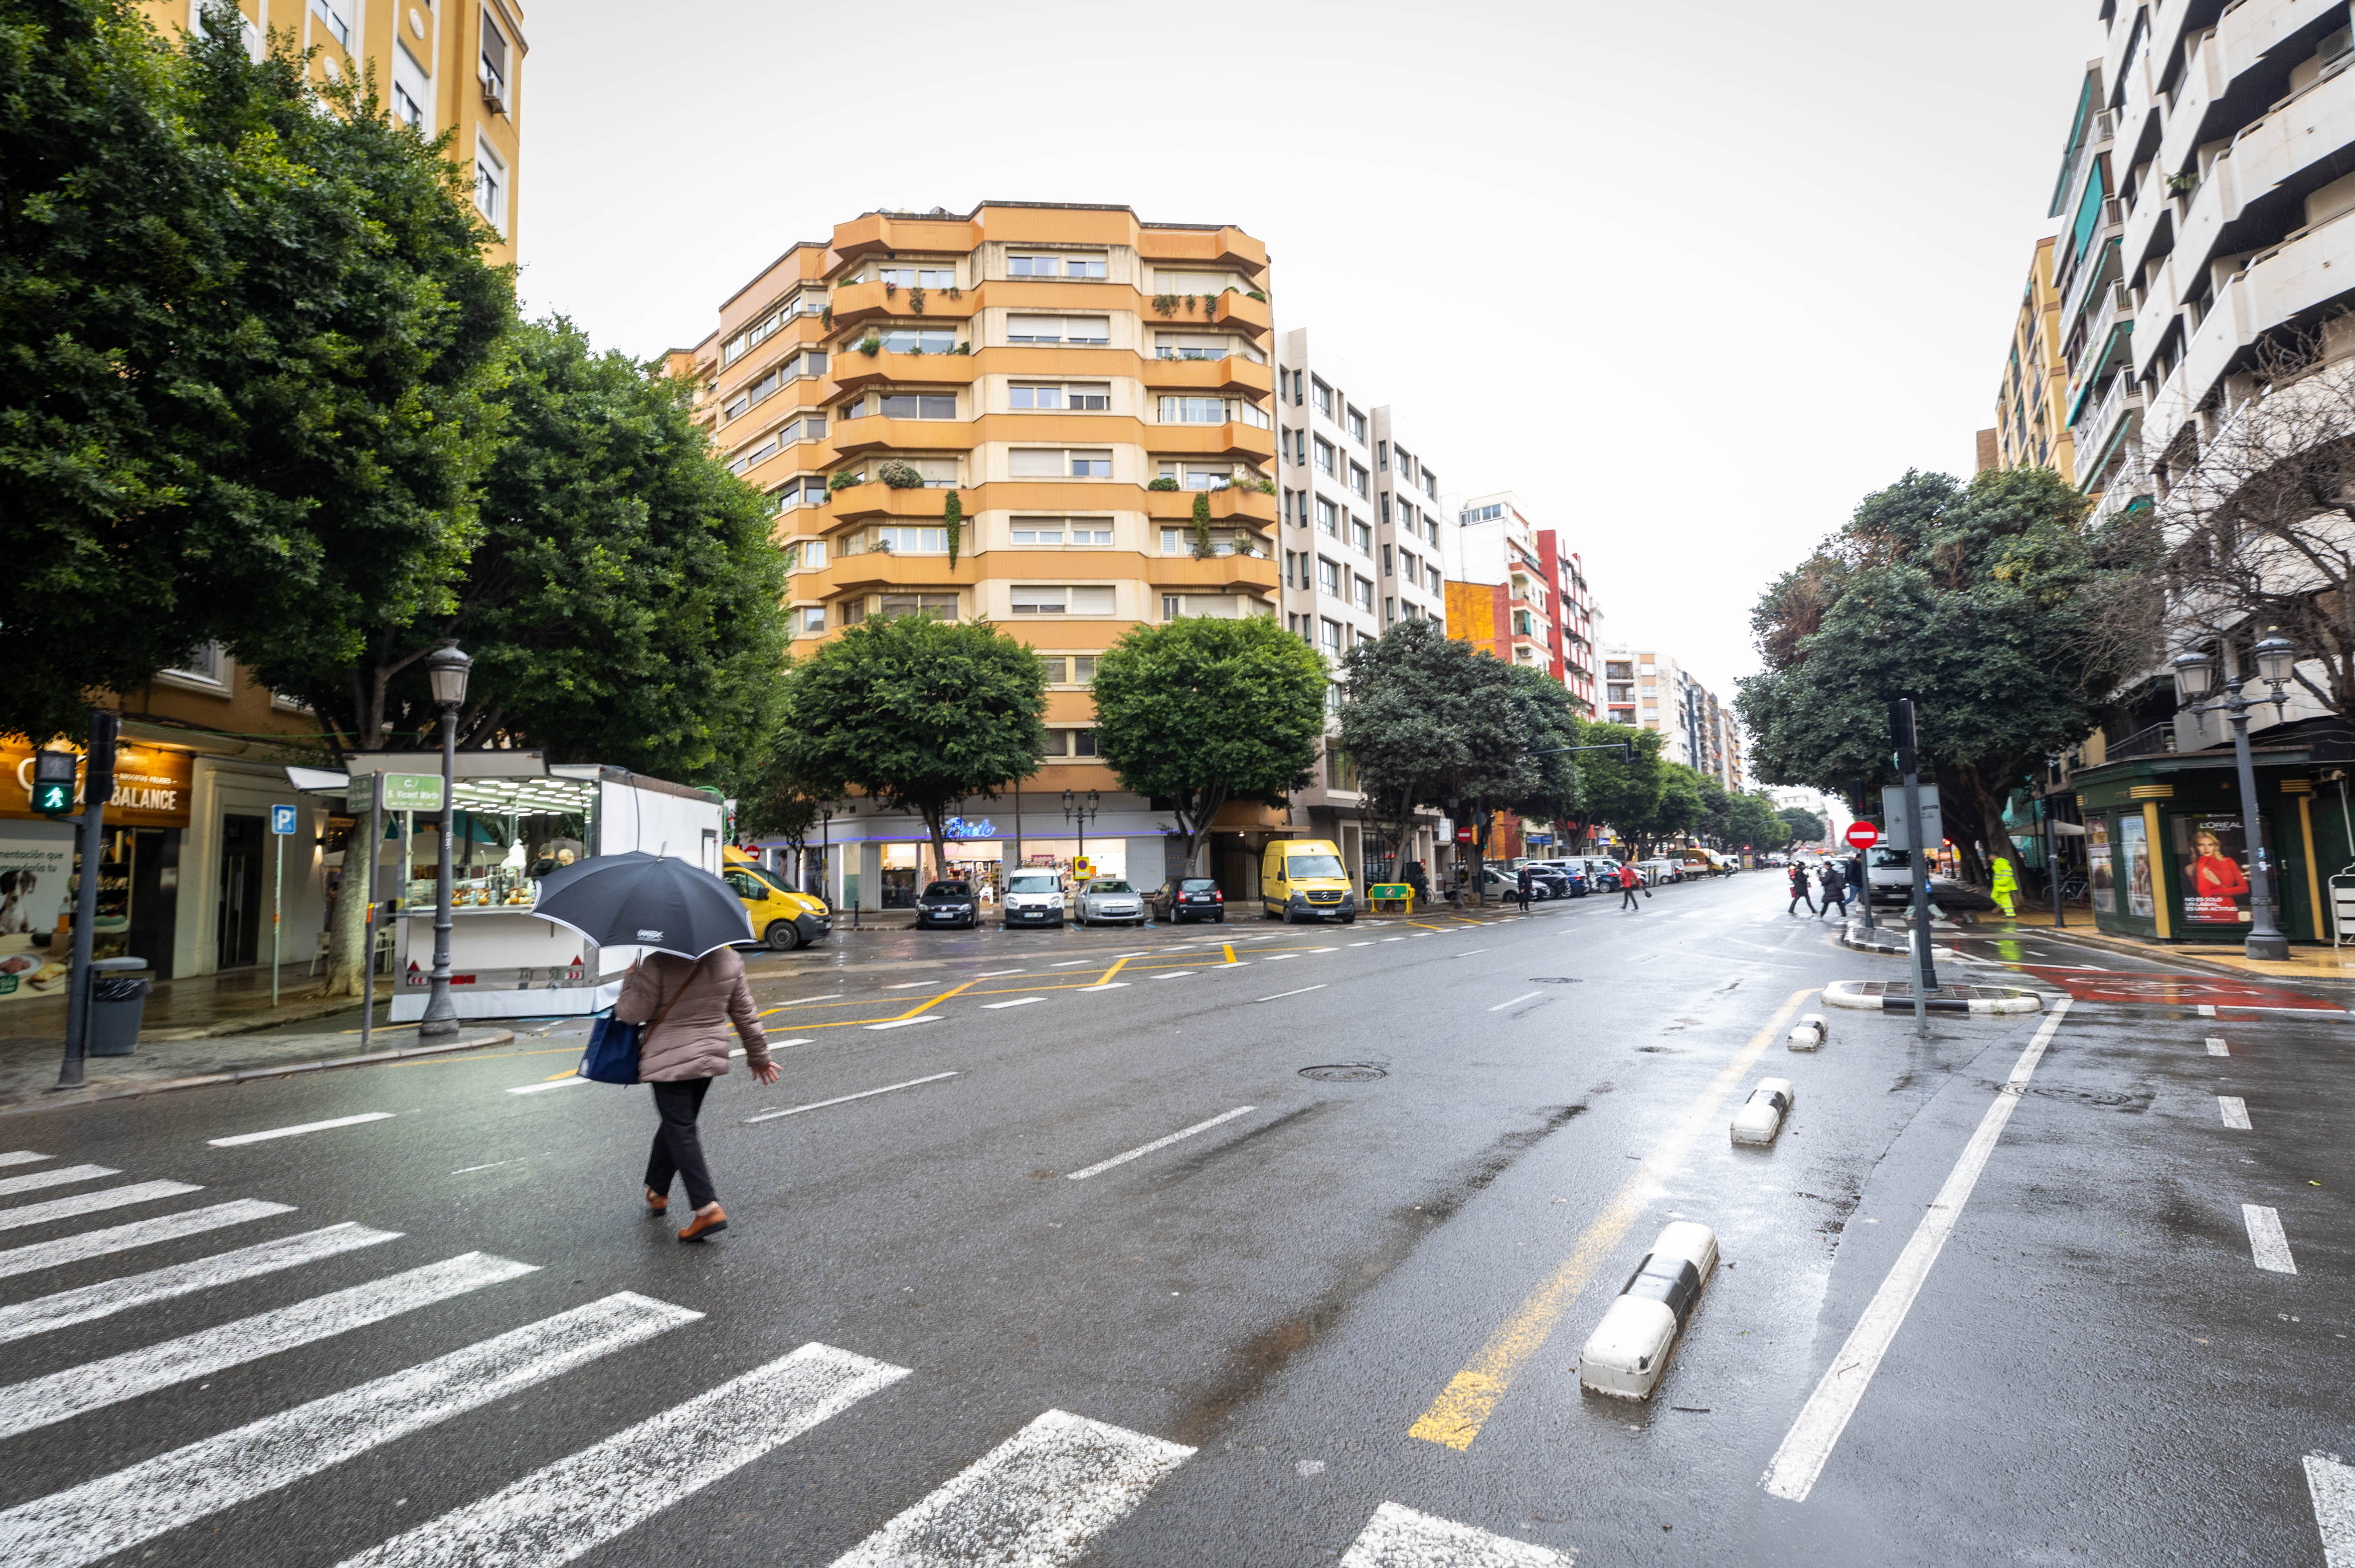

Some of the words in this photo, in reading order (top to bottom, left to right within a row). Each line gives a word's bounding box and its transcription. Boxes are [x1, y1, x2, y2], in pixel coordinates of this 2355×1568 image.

[110, 785, 177, 811] BALANCE
[396, 790, 418, 799] Vicent
[278, 809, 291, 830] P
